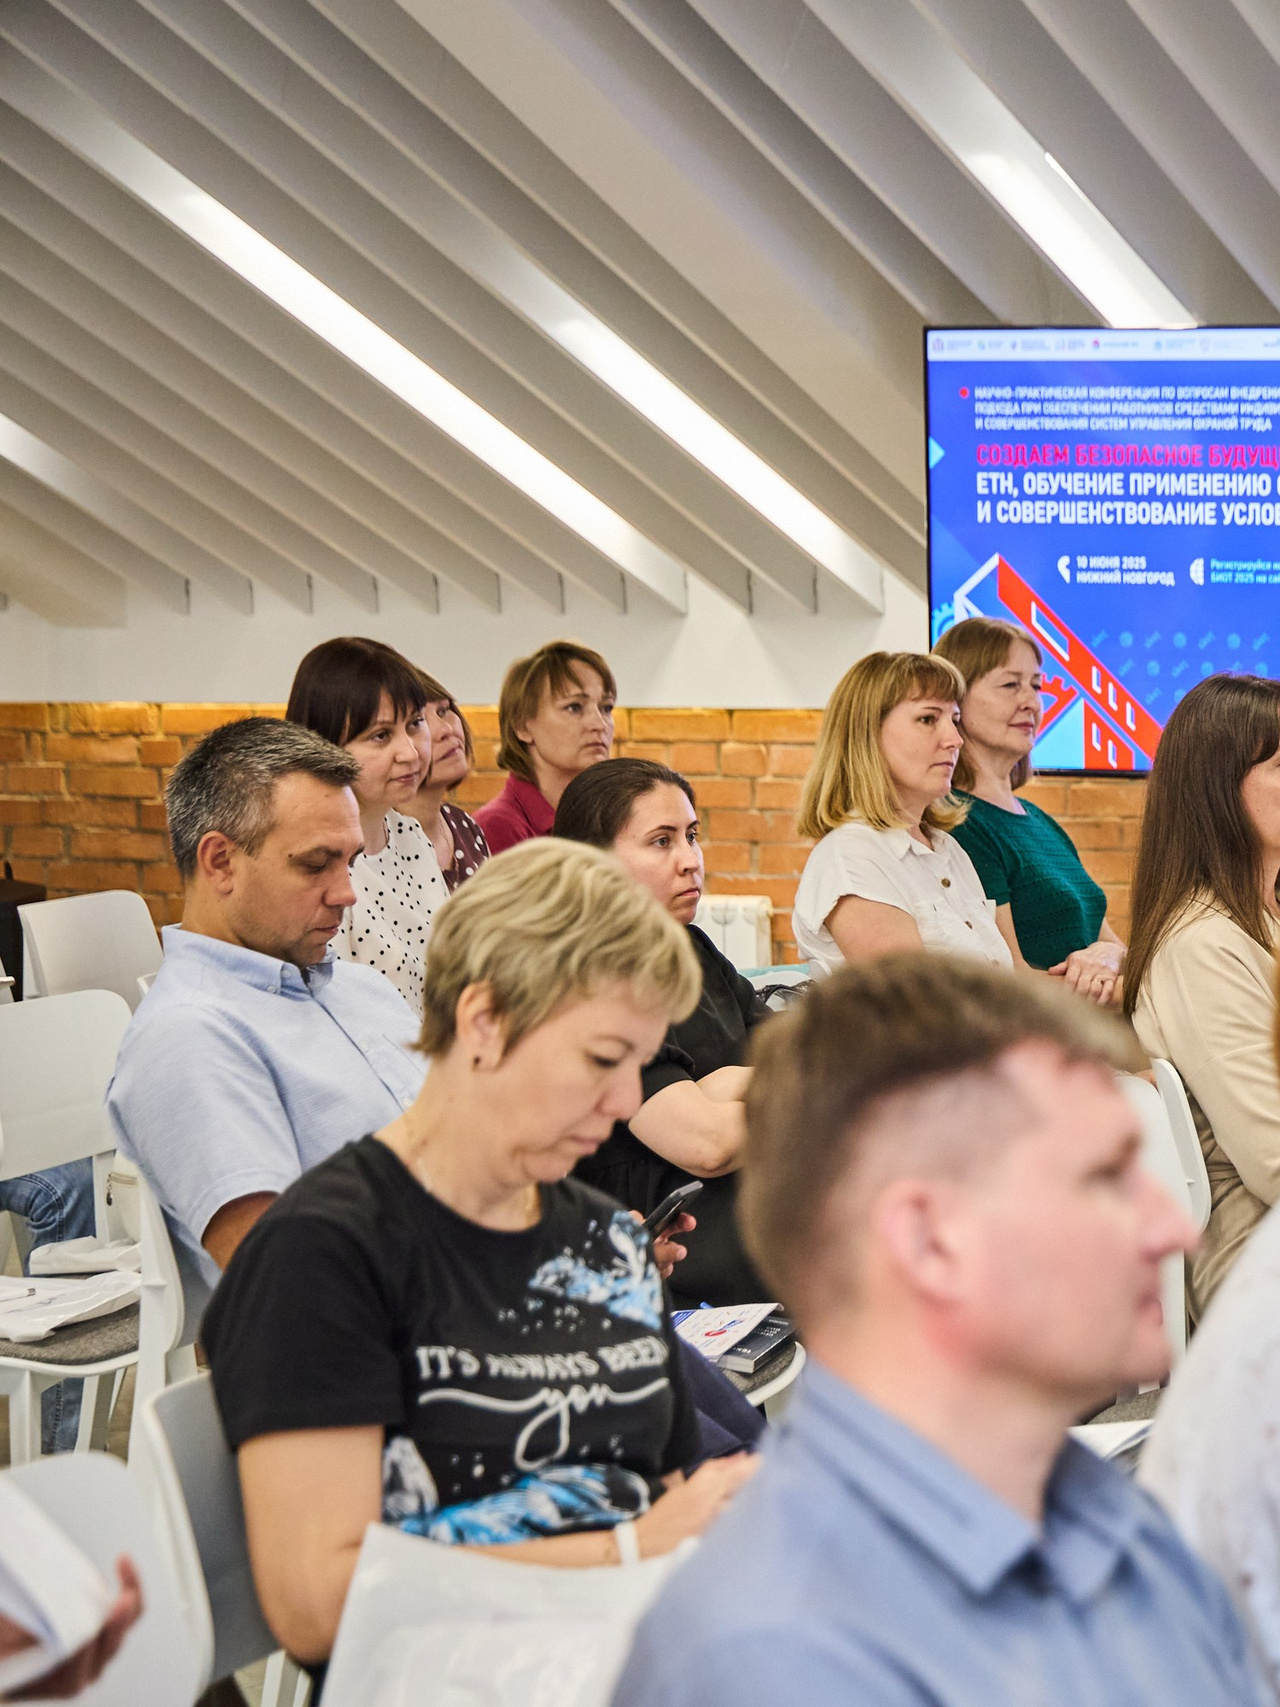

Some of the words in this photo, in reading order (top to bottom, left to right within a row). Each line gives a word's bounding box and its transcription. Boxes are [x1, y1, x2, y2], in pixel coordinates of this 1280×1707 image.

[1089, 386, 1160, 401] КОНФЕРЕНЦИЯ
[1161, 387, 1176, 400] ПО
[1177, 386, 1229, 400] ВОПРОСАМ
[975, 402, 1020, 416] ПОДХОДА
[1021, 402, 1042, 415] ПРИ
[1112, 402, 1173, 415] РАБОТНИКОВ
[1174, 402, 1239, 416] СРЕДСТВАМИ
[975, 417, 984, 430] И
[1090, 417, 1128, 430] СИСТЕМ
[1129, 417, 1192, 431] УПРАВЛЕНИЯ
[1193, 415, 1239, 431] ОХРАНОЙ
[1240, 417, 1273, 432] ТРУДА
[976, 444, 1070, 469] СОЗДАЕМ
[1075, 444, 1203, 467] БЕЗОПАСНОЕ
[976, 471, 1019, 498] ЕТН,
[1022, 472, 1125, 496] ОБУЧЕНИЕ
[1129, 472, 1272, 497] ПРИМЕНЕНИЮ
[976, 500, 992, 524] И
[996, 501, 1217, 526] СОВЕРШЕНСТВОВАНИЕ
[1089, 556, 1121, 569] ИЮНЯ
[1122, 556, 1147, 569] 2025
[1076, 569, 1122, 583] НИЖНИЙ
[1123, 571, 1176, 587] НОВГОРОД
[415, 1345, 481, 1380] IT'S
